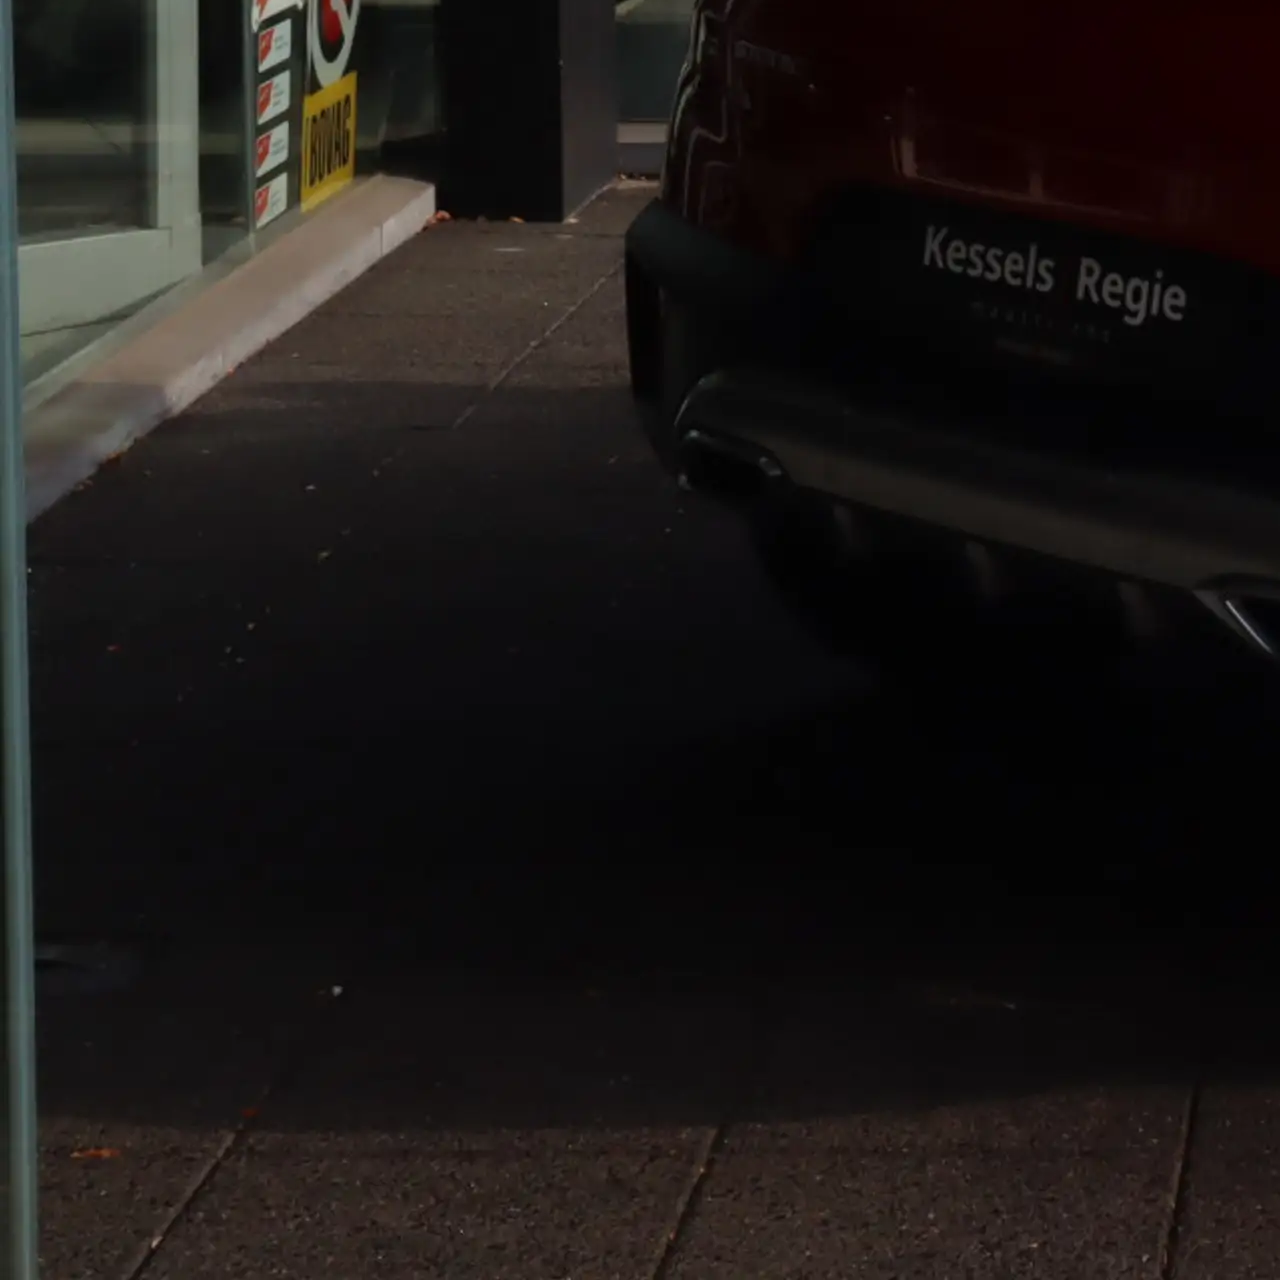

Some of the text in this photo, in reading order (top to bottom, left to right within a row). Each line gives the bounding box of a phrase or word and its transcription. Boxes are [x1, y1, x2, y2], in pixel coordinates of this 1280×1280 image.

[309, 94, 351, 187] BOVAG
[922, 223, 1056, 293] Kessels
[1076, 255, 1188, 327] Regie
